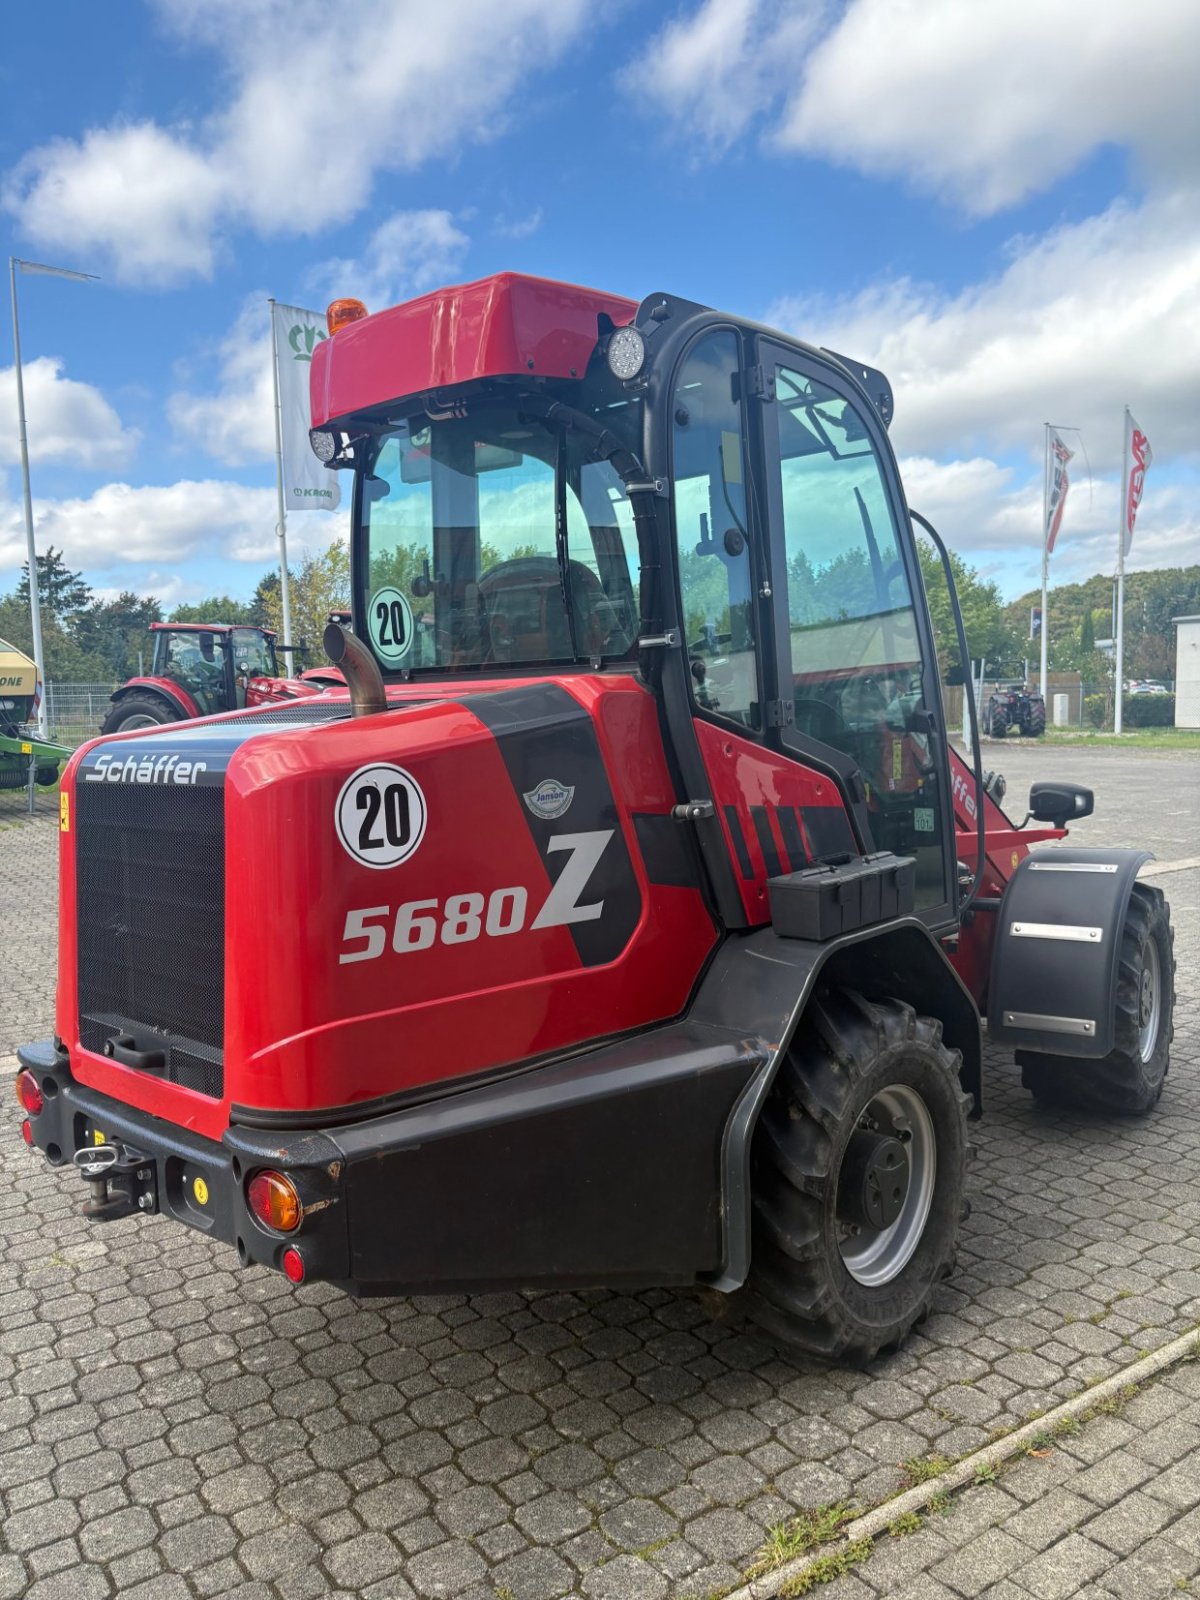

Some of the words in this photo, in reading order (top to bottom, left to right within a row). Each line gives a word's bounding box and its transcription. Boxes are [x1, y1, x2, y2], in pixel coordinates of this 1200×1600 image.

[376, 601, 406, 646] 20
[85, 755, 207, 785] Schäffer
[537, 791, 565, 802] Janson
[356, 784, 410, 850] 20
